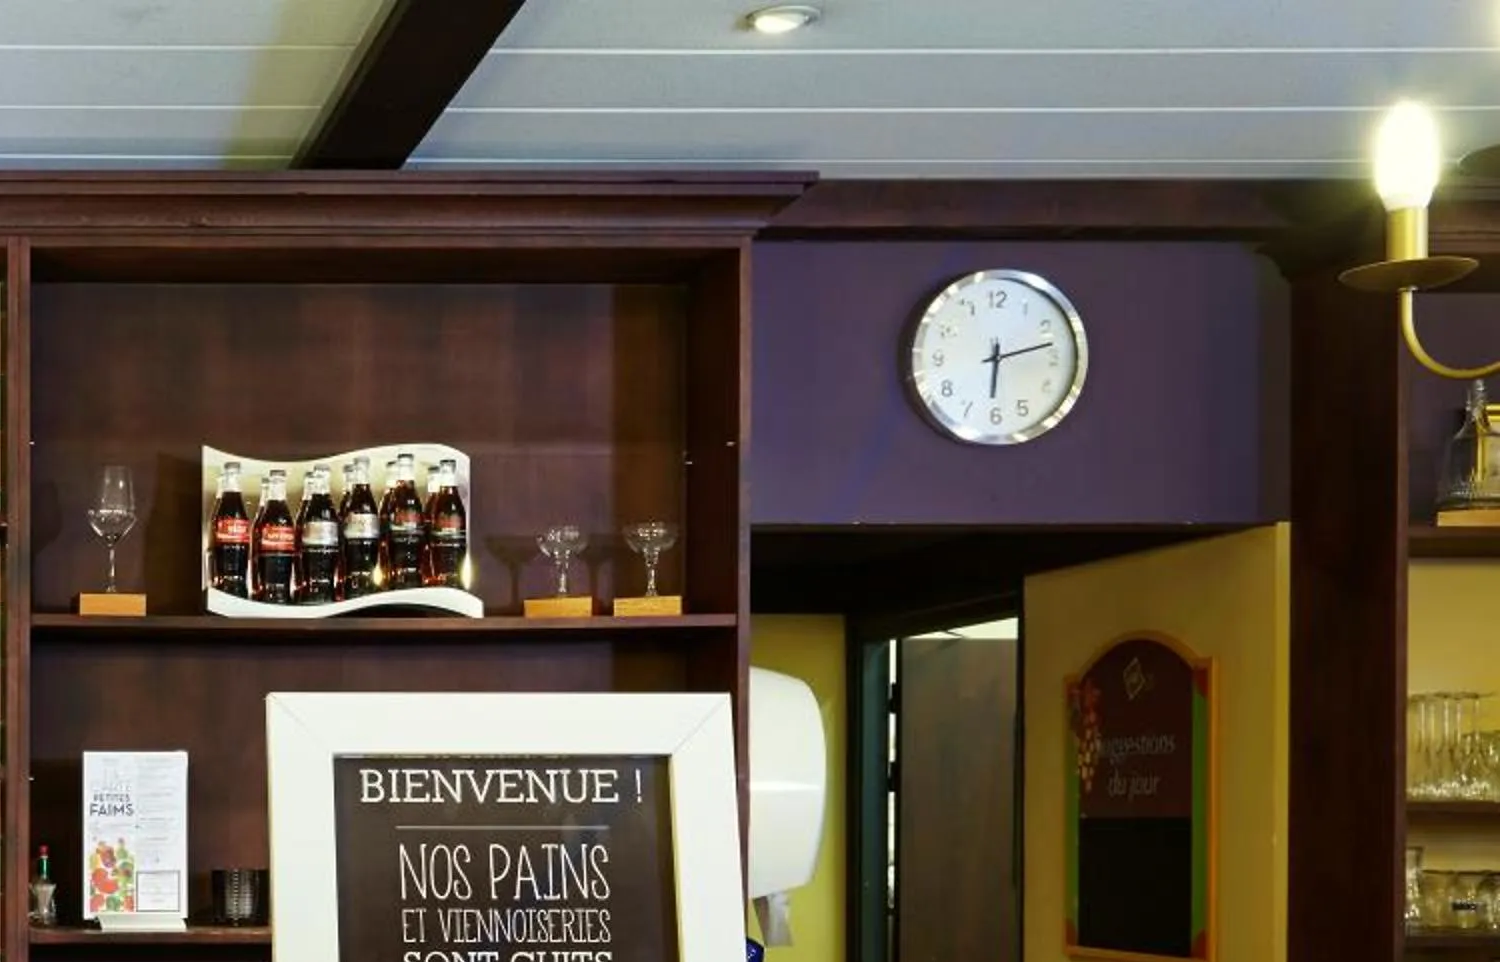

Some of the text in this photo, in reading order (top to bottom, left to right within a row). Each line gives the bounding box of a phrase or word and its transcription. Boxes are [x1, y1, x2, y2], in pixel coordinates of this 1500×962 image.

[987, 290, 1008, 309] 12
[931, 350, 945, 367] 9
[940, 379, 954, 398] 8
[989, 407, 1003, 426] 6
[1016, 399, 1030, 417] 5
[359, 768, 643, 804] BIENVENUE !
[89, 803, 135, 817] FAIMS
[399, 843, 611, 901] NOS PAINS
[402, 908, 612, 944] ET VIENNOISERIES
